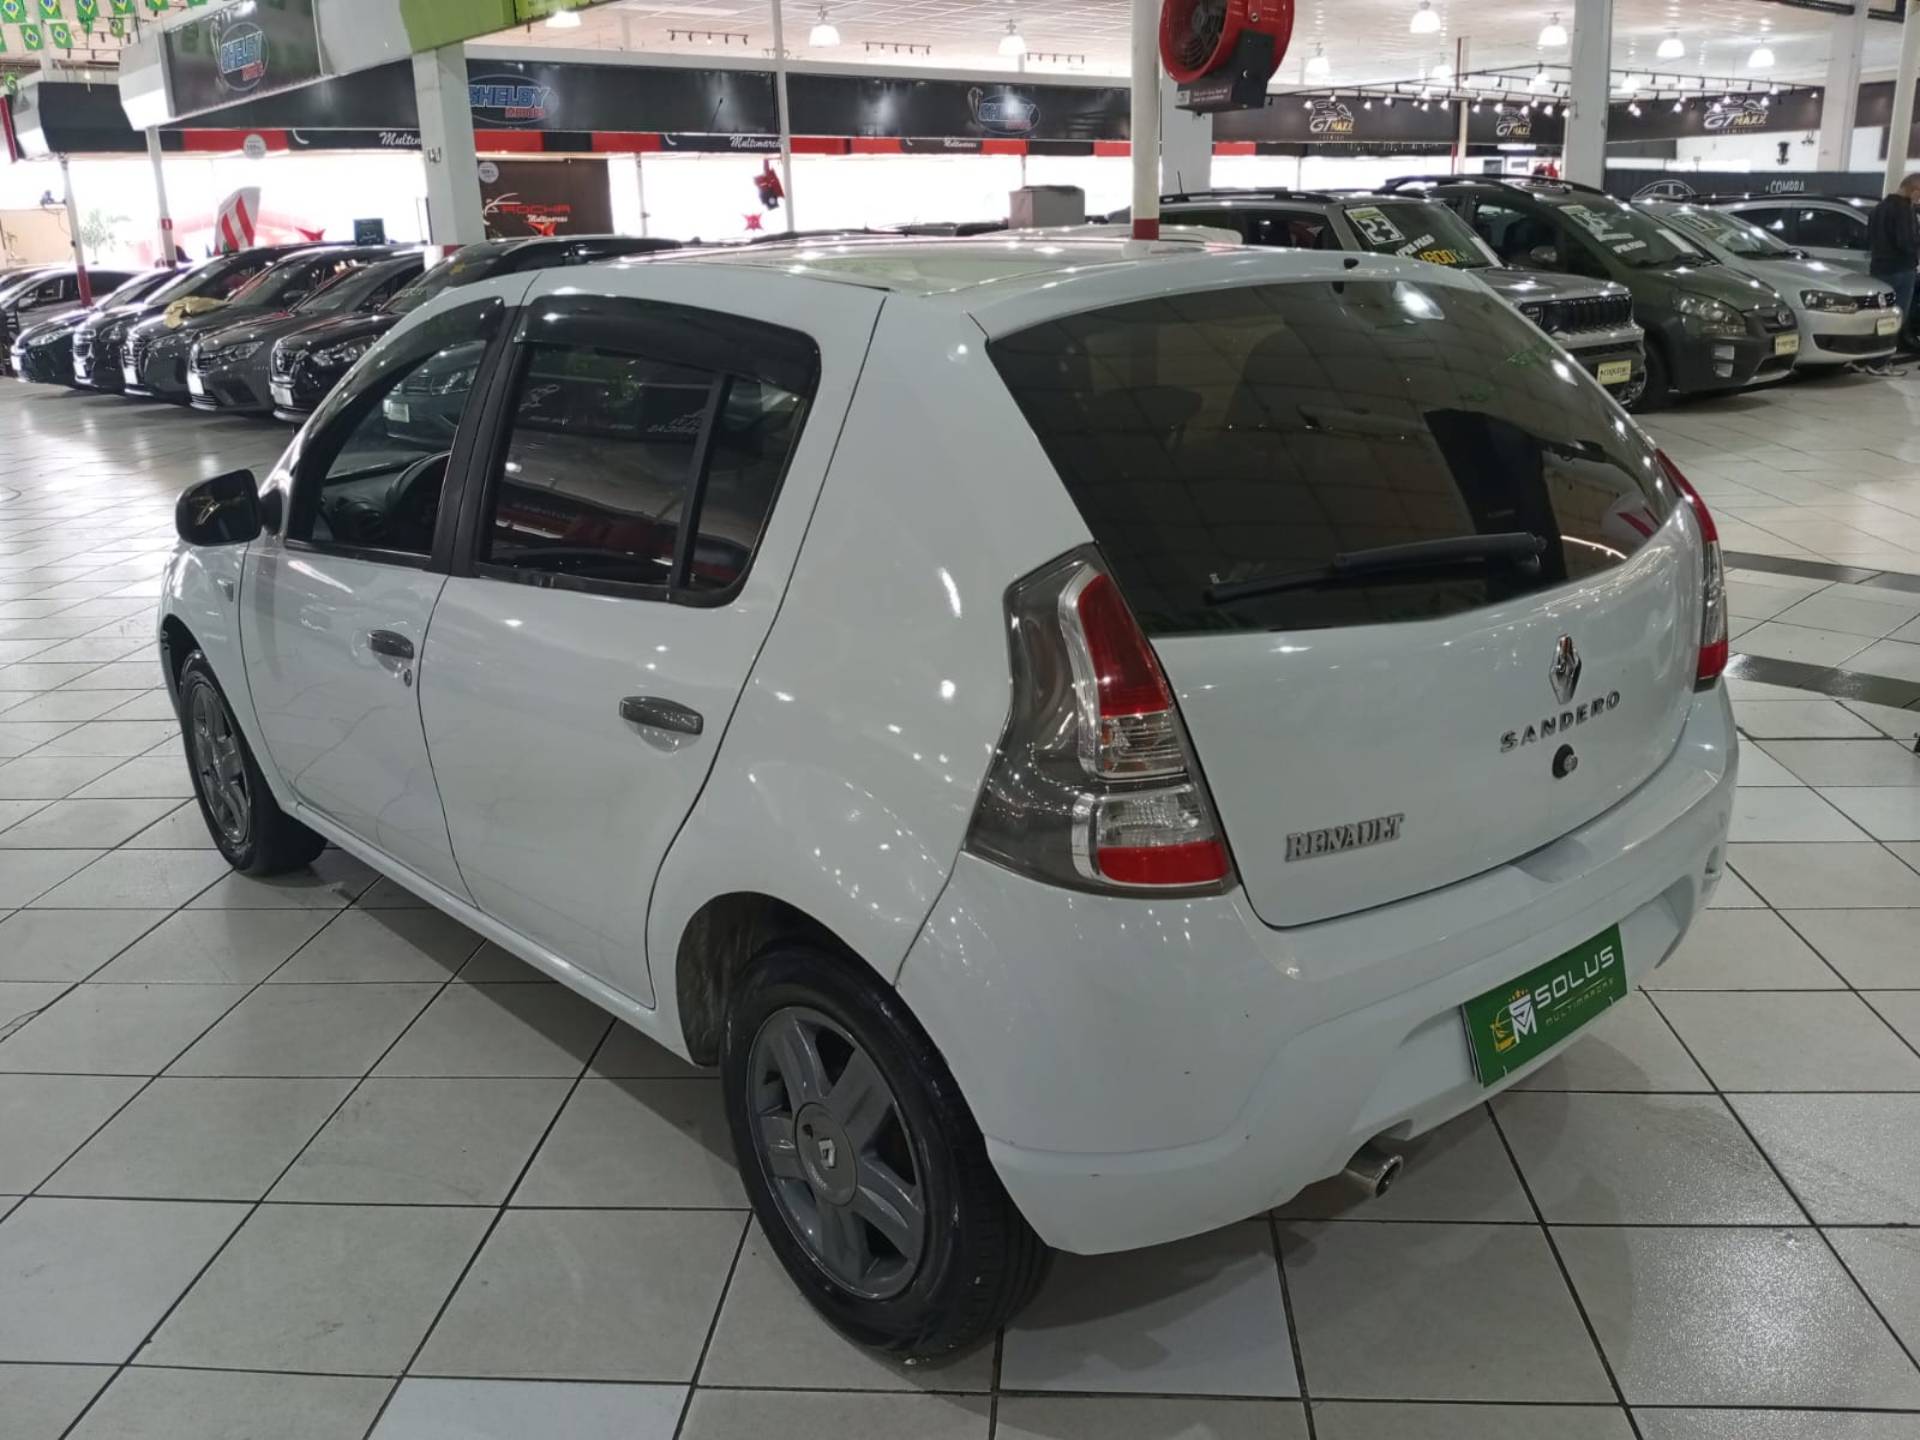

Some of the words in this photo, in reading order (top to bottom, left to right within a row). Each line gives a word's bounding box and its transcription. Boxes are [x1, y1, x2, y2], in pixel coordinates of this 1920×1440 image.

[1500, 690, 1620, 753] SANDERO
[1285, 813, 1405, 862] RENAULT
[1534, 945, 1615, 1009] SOLUS
